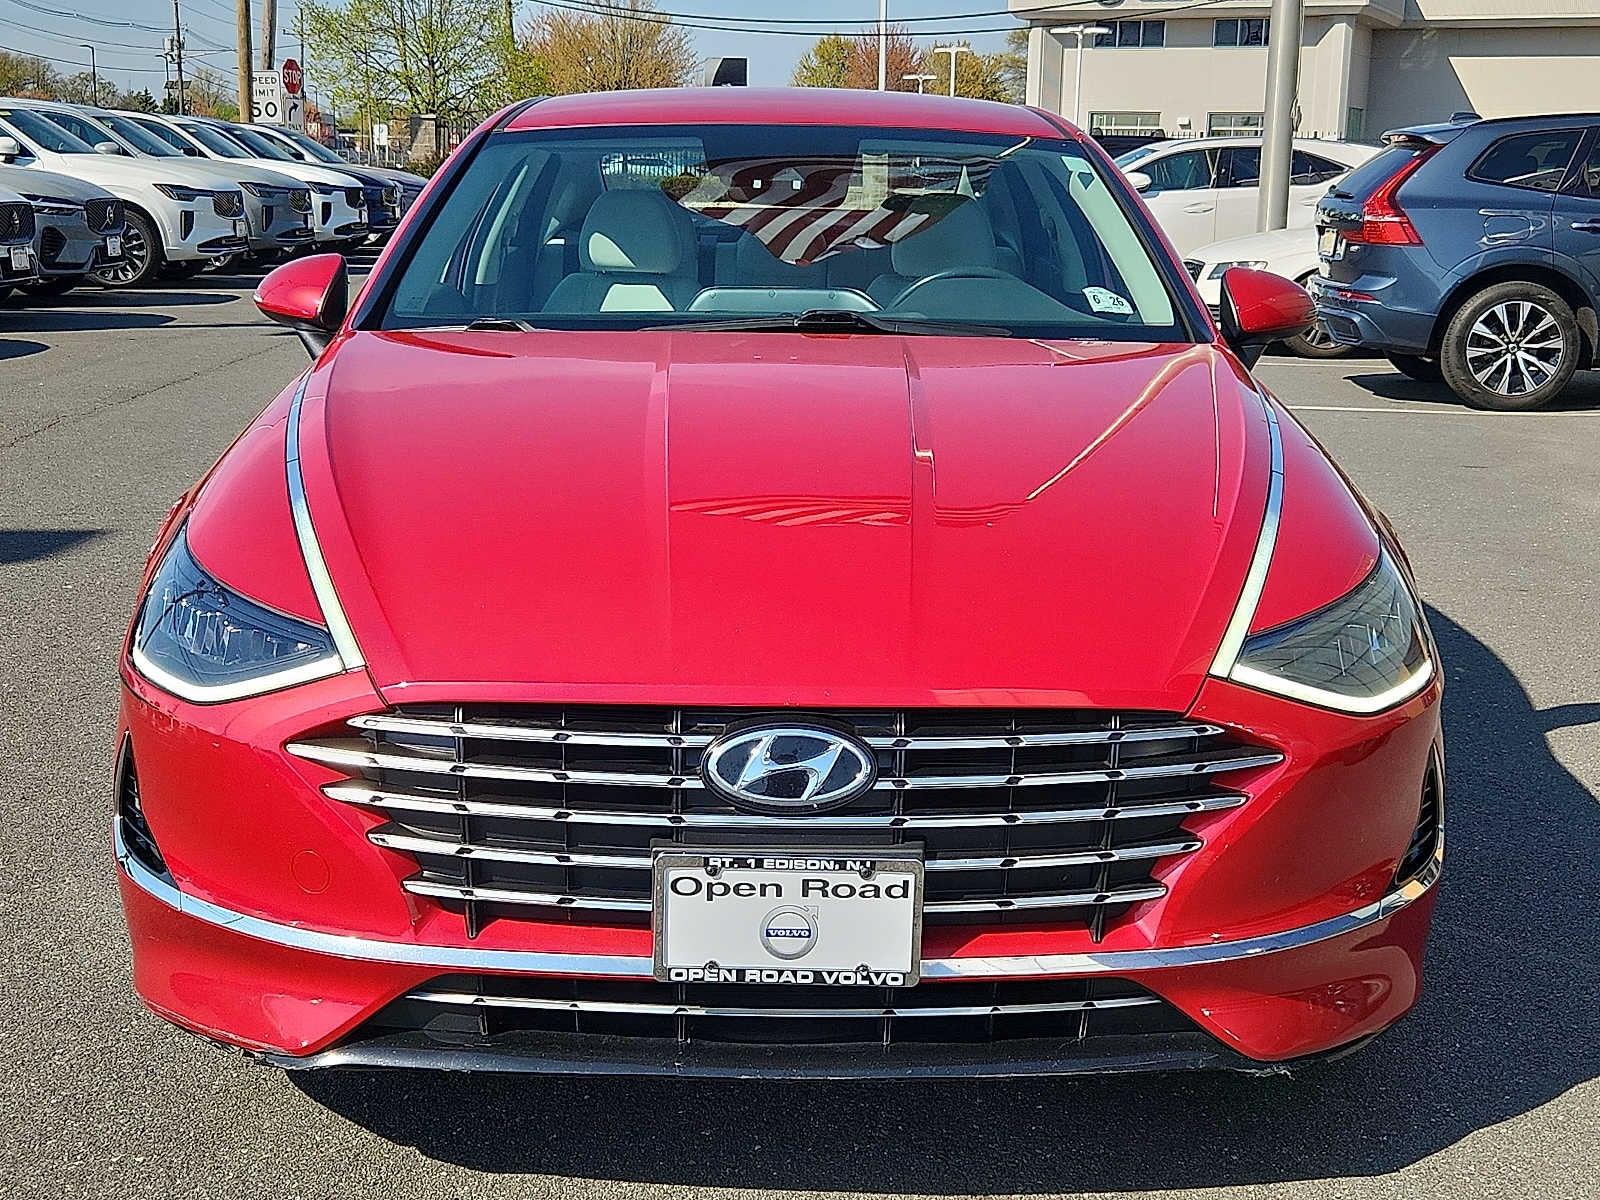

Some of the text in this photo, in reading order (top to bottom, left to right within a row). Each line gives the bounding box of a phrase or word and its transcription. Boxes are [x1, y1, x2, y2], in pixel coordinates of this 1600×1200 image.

[284, 70, 301, 84] STOP
[252, 102, 277, 117] 50
[1093, 295, 1124, 306] 6 26
[747, 859, 756, 868] 1
[763, 859, 839, 870] EDISON,
[670, 876, 910, 901] Open Road
[768, 929, 809, 938] VOLVO
[670, 968, 904, 986] OPEN ROAD VOLVO
